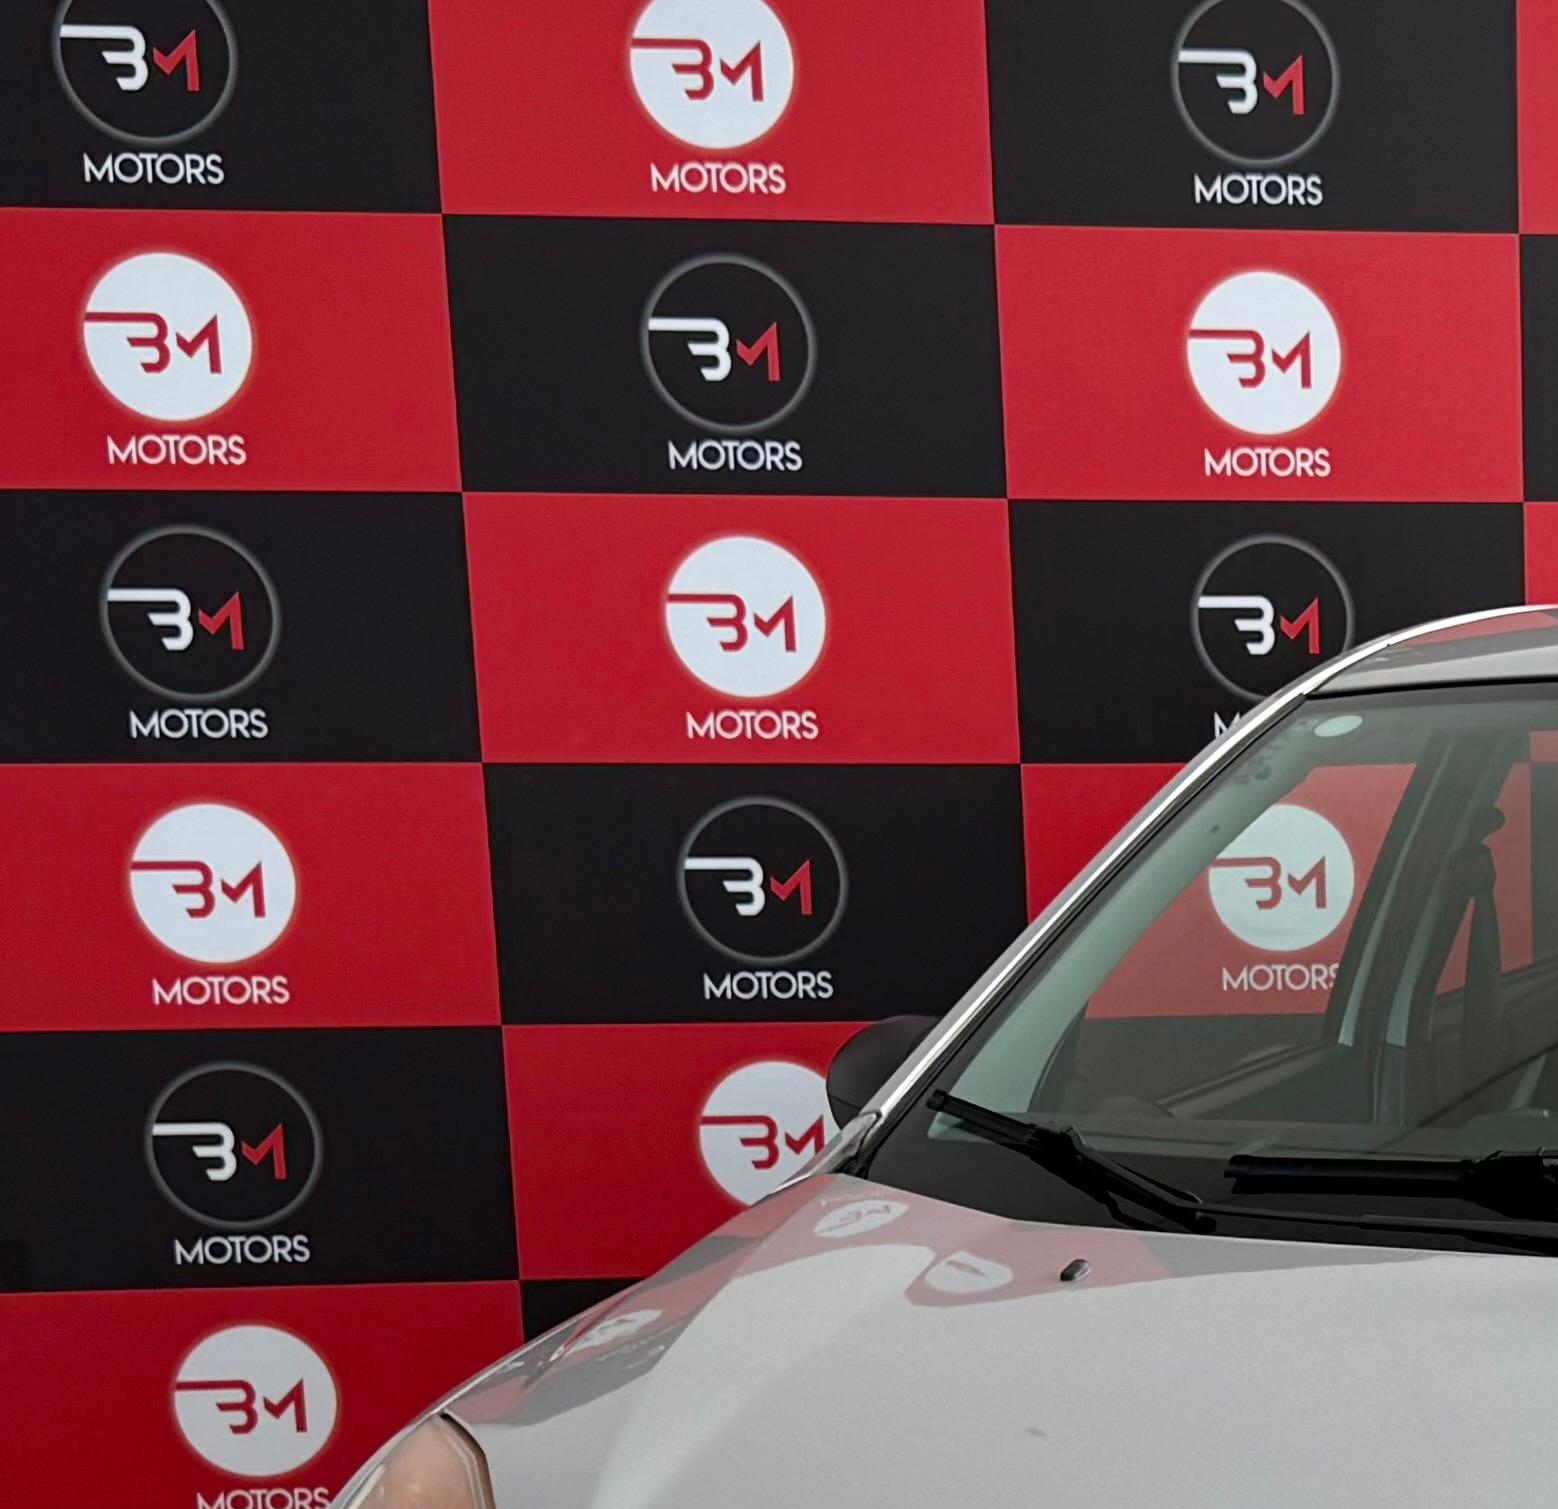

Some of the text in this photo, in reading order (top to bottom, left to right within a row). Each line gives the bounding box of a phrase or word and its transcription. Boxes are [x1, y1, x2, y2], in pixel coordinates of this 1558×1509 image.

[60, 25, 200, 91] BM
[631, 39, 764, 102] BM
[1179, 50, 1305, 115] BM
[84, 153, 224, 185] MOTORS
[651, 162, 786, 194] MOTORS
[1195, 174, 1322, 205] MOTORS
[85, 311, 222, 375] BM
[649, 317, 780, 382] BM
[1189, 329, 1312, 390] BM
[107, 435, 246, 465] MOTORS
[668, 440, 802, 471] MOTORS
[1204, 448, 1331, 478] MOTORS
[107, 588, 245, 651] BM
[667, 593, 797, 653] BM
[1198, 595, 1320, 655] BM
[130, 708, 268, 739] MOTORS
[687, 709, 818, 739] MOTORS
[131, 860, 266, 918] BM
[684, 857, 812, 916] BM
[1211, 856, 1327, 910] BM
[152, 975, 290, 1005] MOTORS
[704, 971, 833, 999] MOTORS
[152, 1122, 287, 1181] BM
[700, 1114, 825, 1170] BM
[174, 1235, 310, 1264] MOTORS
[175, 1378, 308, 1435] BM
